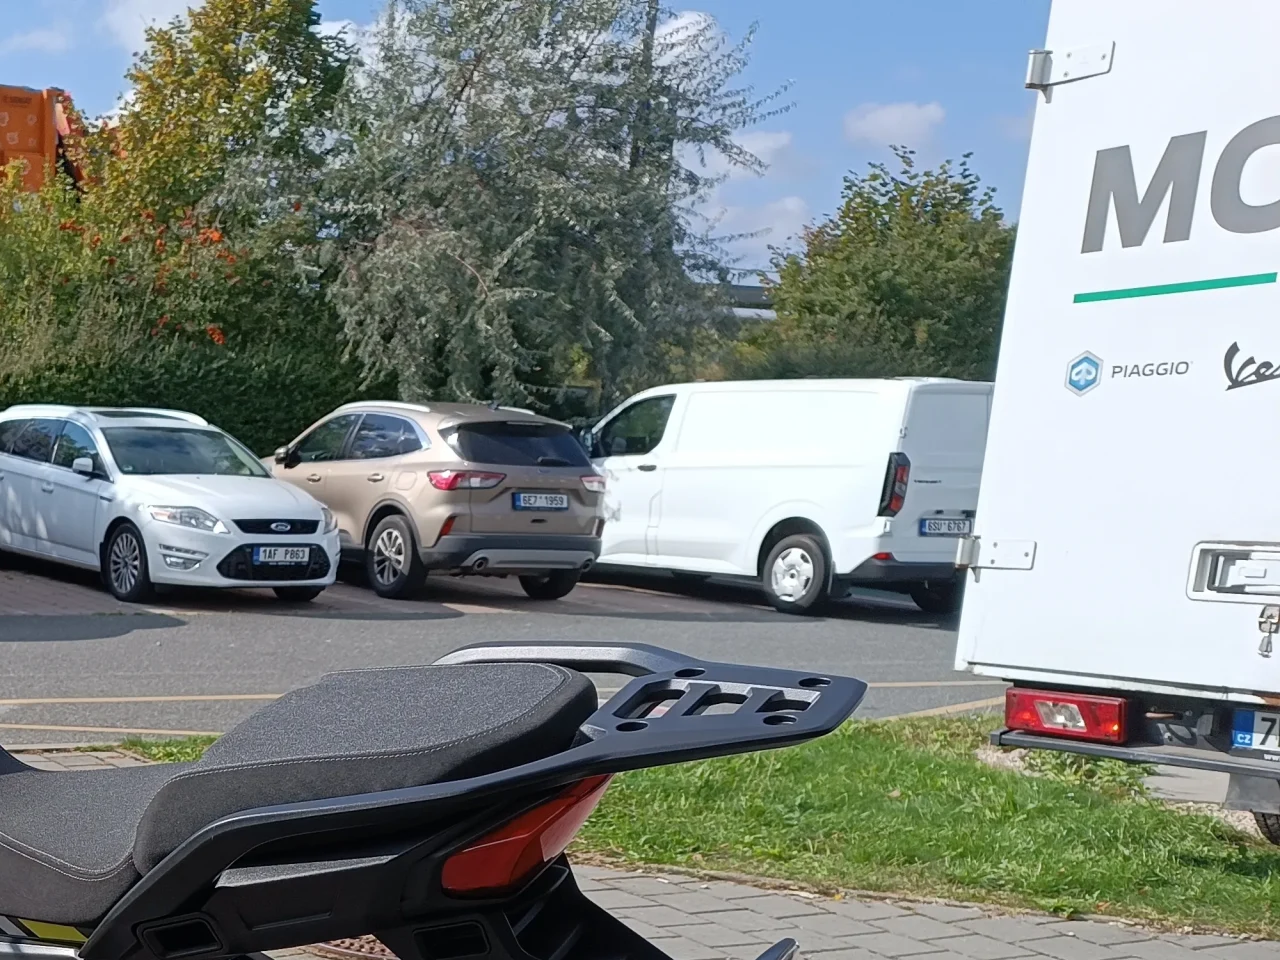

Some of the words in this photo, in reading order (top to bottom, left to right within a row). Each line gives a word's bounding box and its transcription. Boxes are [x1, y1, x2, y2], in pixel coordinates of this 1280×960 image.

[1111, 361, 1190, 379] PIAGGIO
[1237, 733, 1252, 744] CZ
[1259, 716, 1280, 748] 7
